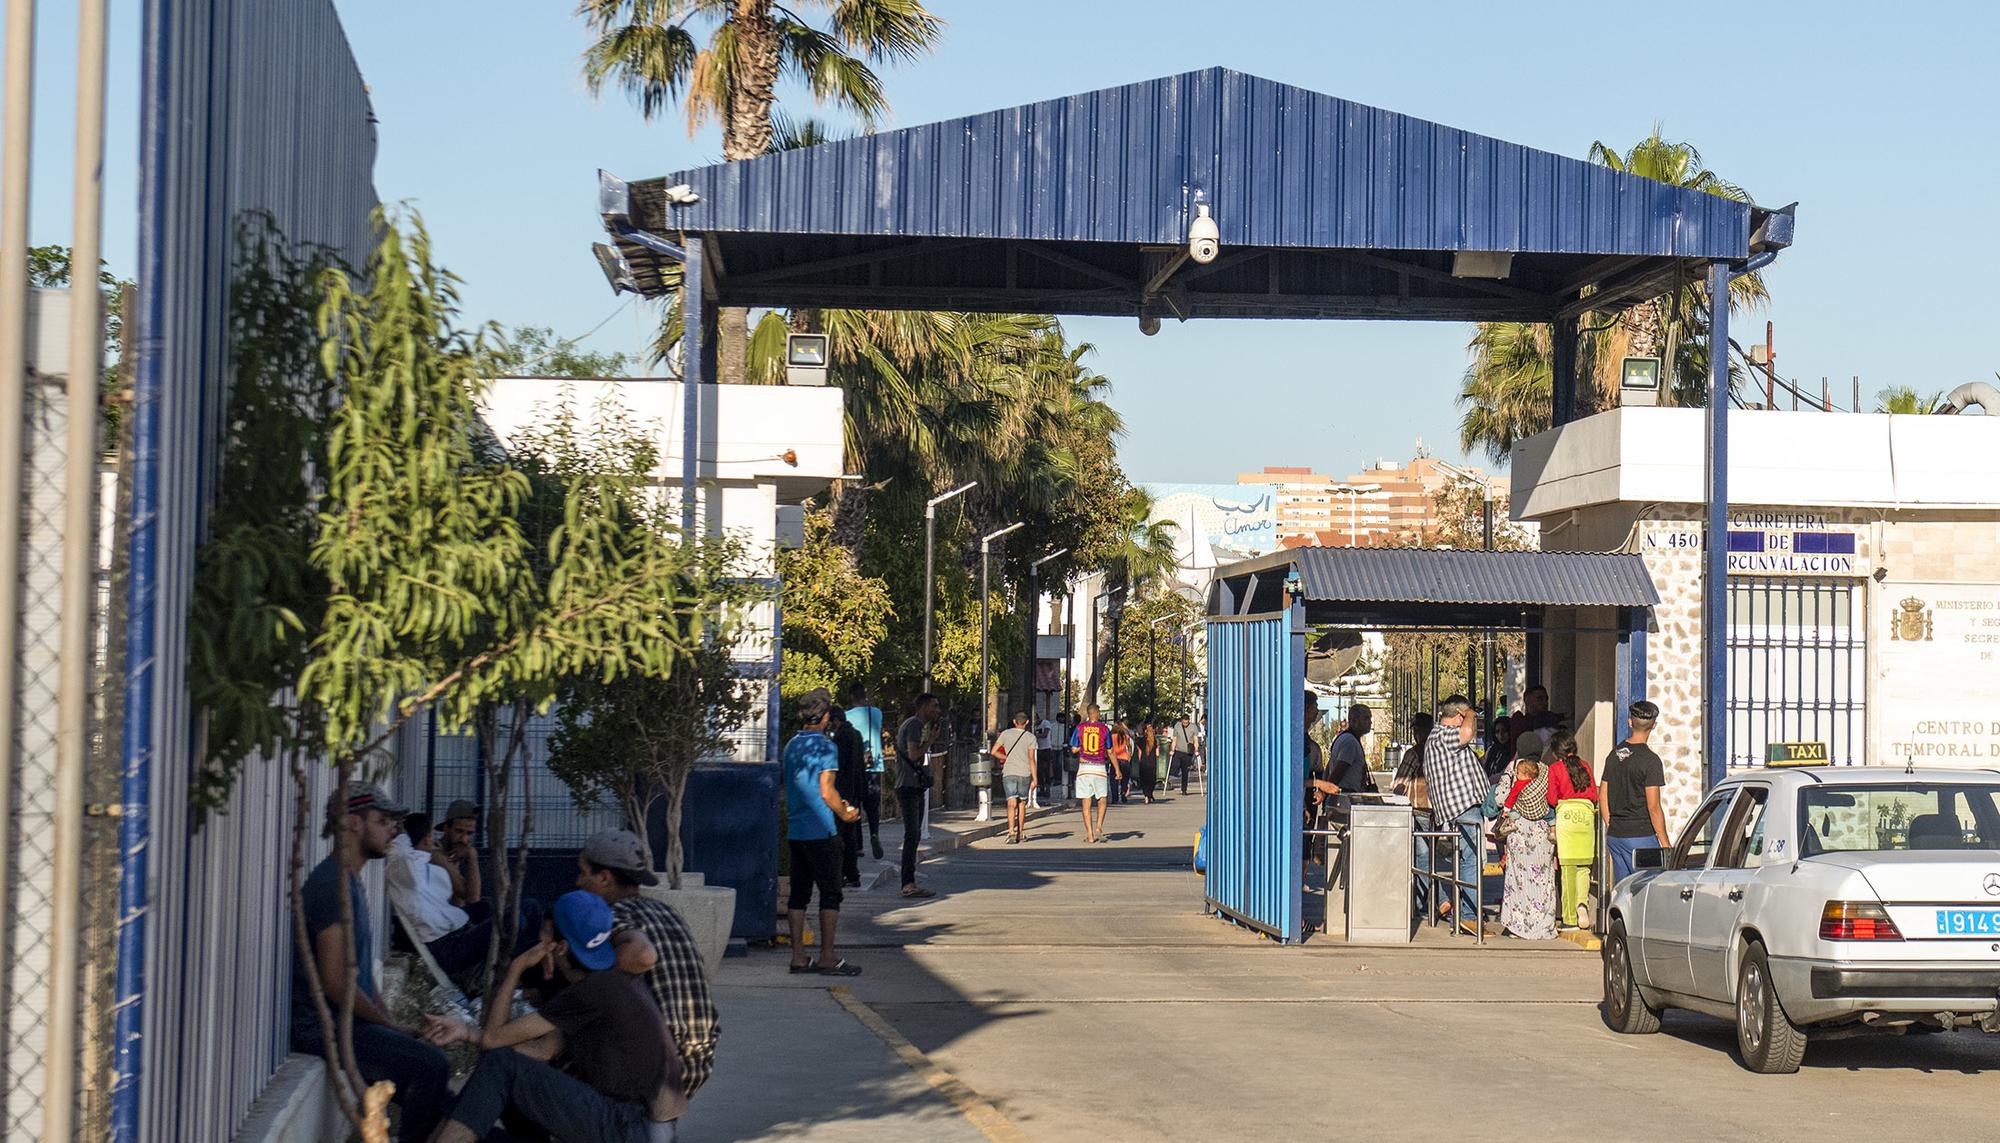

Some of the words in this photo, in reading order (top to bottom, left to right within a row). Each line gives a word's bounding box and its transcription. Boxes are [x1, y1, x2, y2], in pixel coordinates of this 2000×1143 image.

[1733, 513, 1825, 529] CARRETERA
[1646, 534, 1656, 547] N
[1668, 533, 1698, 548] 450
[1769, 535, 1789, 550] DE
[1728, 555, 1851, 571] RCUNVALACION
[1936, 600, 1994, 610] MINISTERIO
[1916, 720, 1984, 735] CENTRO
[1083, 732, 1099, 752] 10
[1787, 745, 1822, 759] TAXI
[1892, 743, 1983, 757] TEMPORAL
